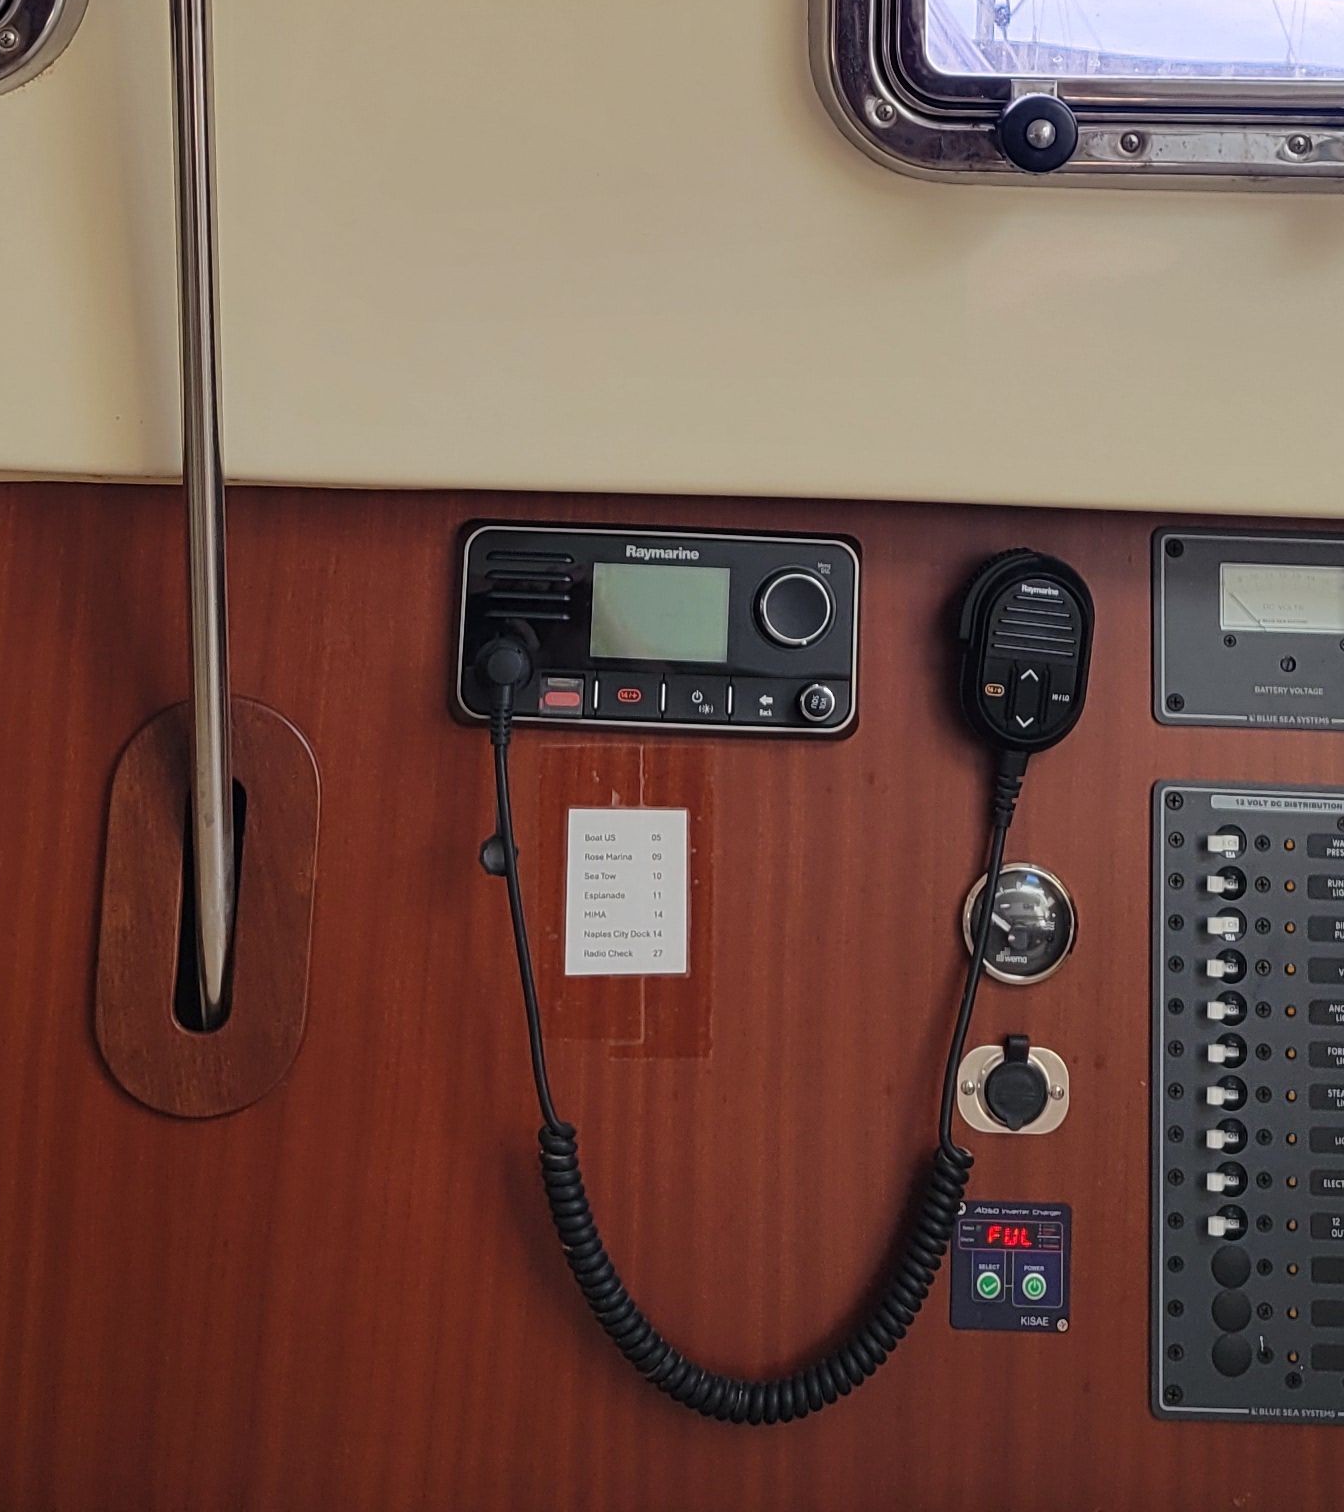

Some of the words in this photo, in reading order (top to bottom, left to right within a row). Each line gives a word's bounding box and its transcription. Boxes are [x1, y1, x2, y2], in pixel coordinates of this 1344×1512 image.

[626, 544, 700, 560] Raymarine
[1022, 584, 1059, 596] Raymarine
[1254, 686, 1289, 694] BATTERY
[1290, 687, 1324, 696] VOLTAGE
[1278, 716, 1296, 724] SEA
[1297, 716, 1330, 724] SYSTEMS
[1247, 800, 1268, 808] VOLT
[1270, 800, 1282, 808] DC
[1284, 801, 1342, 810] DISTRIBUTION
[604, 834, 616, 842] US
[584, 853, 604, 861] Rose
[606, 853, 632, 861] Marina
[652, 853, 662, 861] 09
[584, 872, 599, 880] Sea
[601, 872, 616, 880] Tow
[653, 872, 662, 880] 10
[584, 892, 625, 900] Esplanade
[584, 930, 612, 939] Naples
[613, 930, 629, 939] City
[630, 930, 650, 938] Dock
[653, 930, 662, 938] 14
[1005, 955, 1027, 964] wema
[1332, 1218, 1340, 1226] 12
[987, 1225, 1032, 1247] FUL
[1020, 1316, 1049, 1326] KISAE
[1259, 1408, 1280, 1417] BLUE
[1283, 1408, 1300, 1417] SEA
[1301, 1409, 1336, 1418] SYSTEMS
